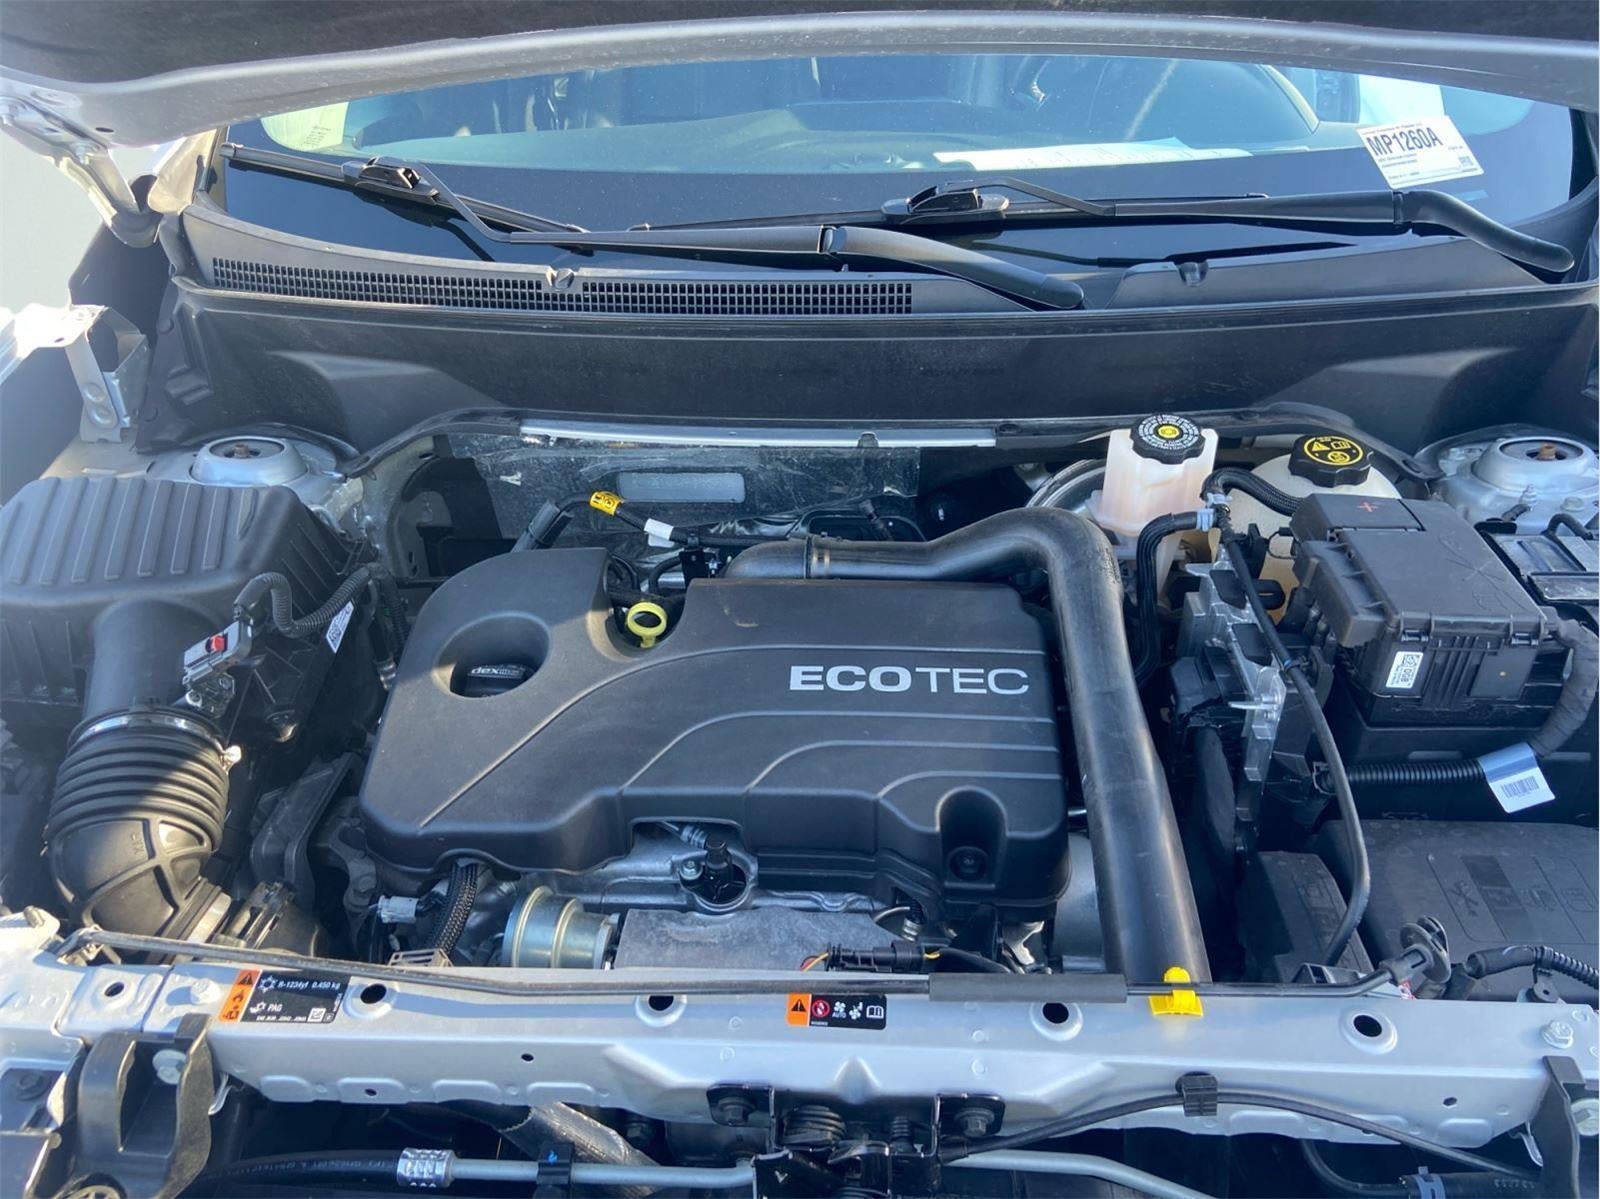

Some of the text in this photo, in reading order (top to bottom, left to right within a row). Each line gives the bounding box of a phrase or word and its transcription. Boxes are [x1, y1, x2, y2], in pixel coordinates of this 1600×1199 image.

[1366, 127, 1444, 157] MP1260A
[789, 665, 1029, 695] ECOTEC
[267, 1003, 283, 1013] PAG
